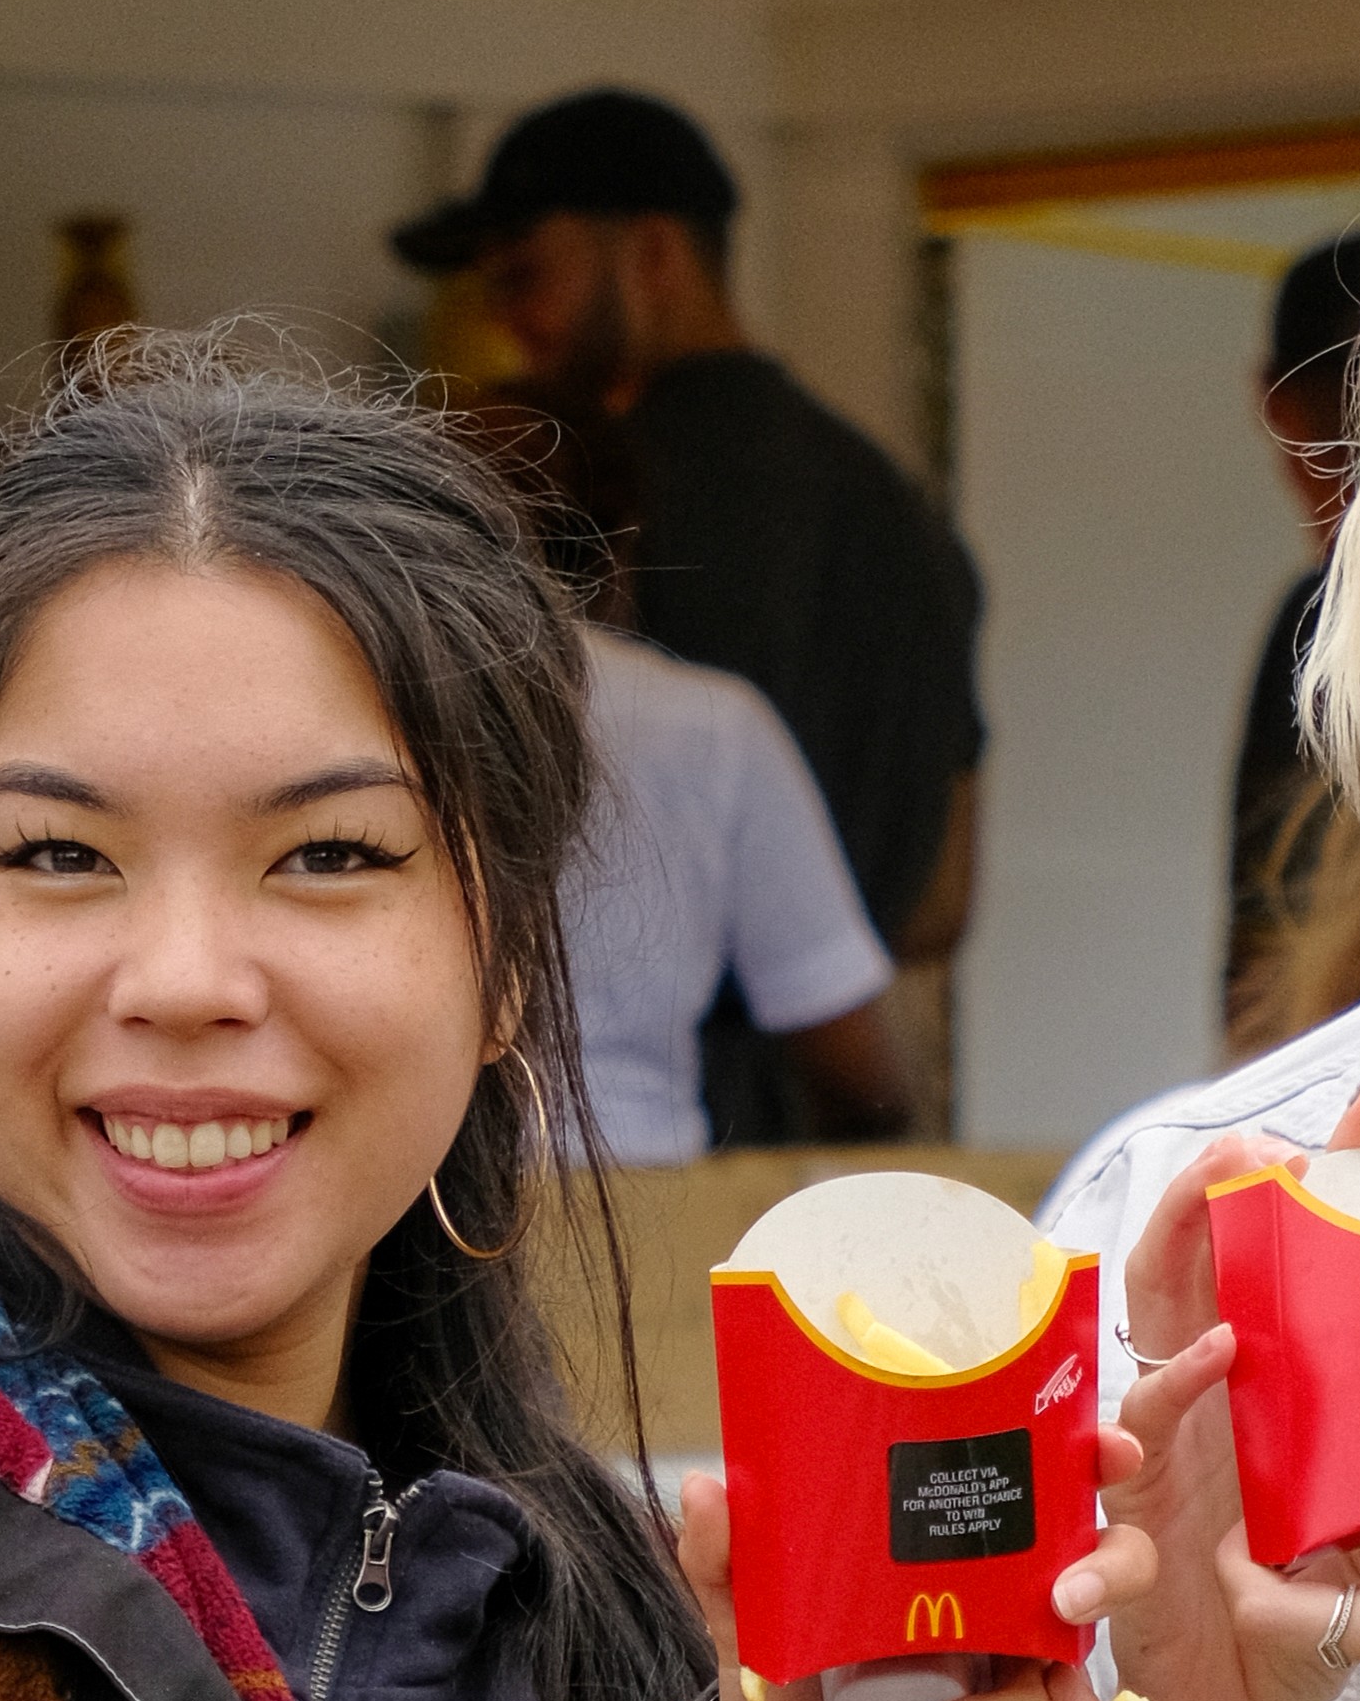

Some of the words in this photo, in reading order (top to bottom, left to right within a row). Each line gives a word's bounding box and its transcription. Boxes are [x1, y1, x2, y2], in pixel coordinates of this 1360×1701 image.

[930, 1468, 978, 1484] COLLECT
[980, 1466, 999, 1479] VIA
[989, 1477, 1010, 1490] APP
[903, 1500, 926, 1511] FOR
[928, 1496, 980, 1510] ANOTHER
[982, 1488, 1023, 1505] CHANCE
[946, 1510, 961, 1522] TO
[962, 1508, 986, 1520] WIN
[929, 1523, 966, 1537] RULES
[968, 1518, 1002, 1533] APPLY
